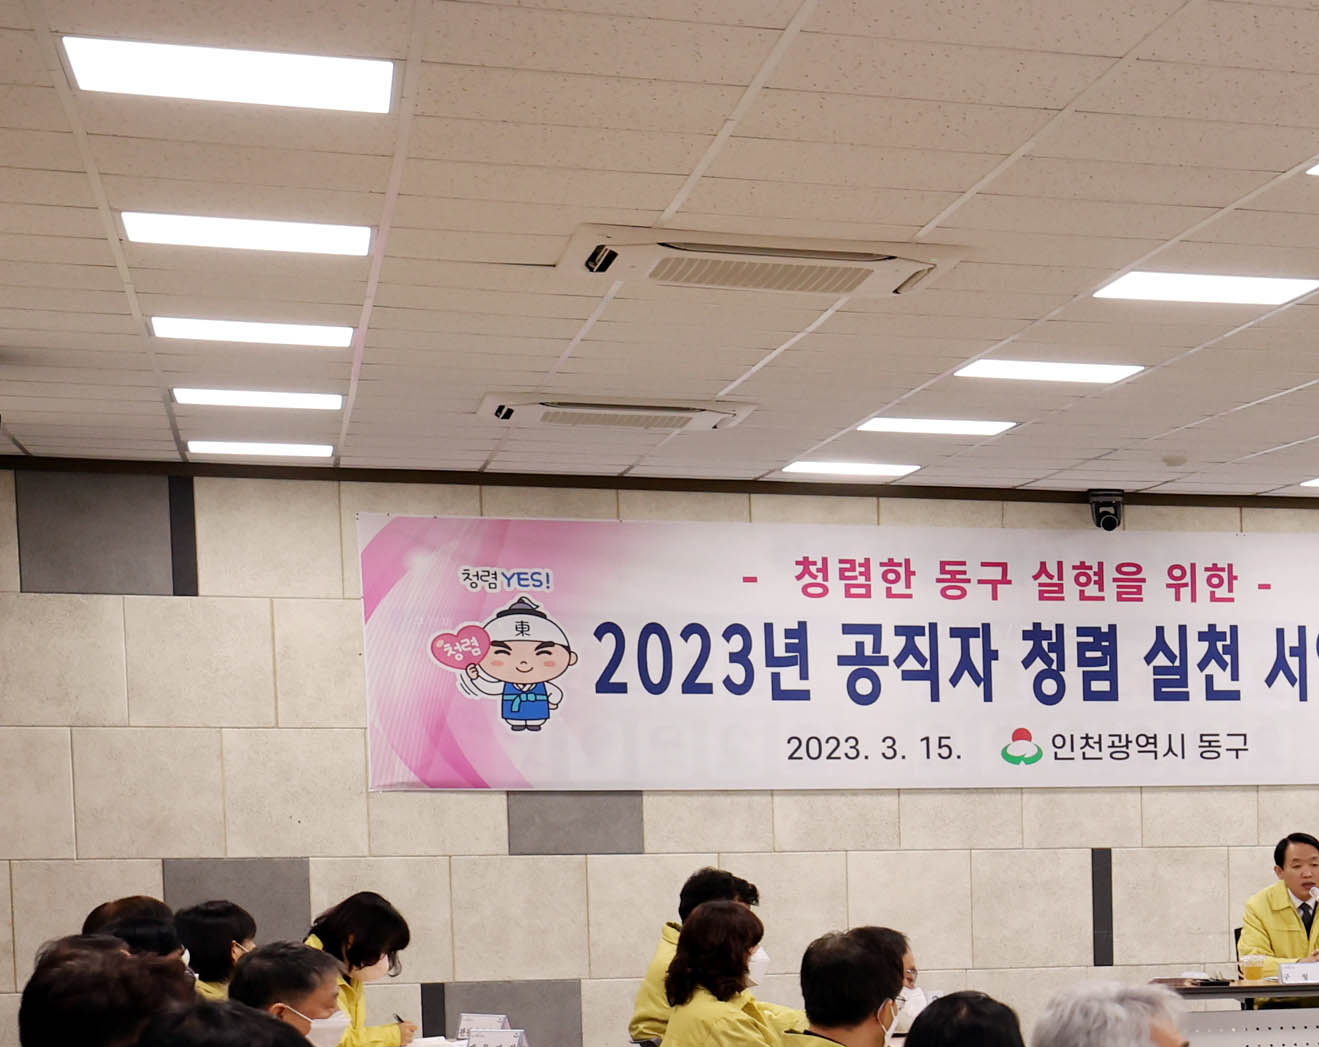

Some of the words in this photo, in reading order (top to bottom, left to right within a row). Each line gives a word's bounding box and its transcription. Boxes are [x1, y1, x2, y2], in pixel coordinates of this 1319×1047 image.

[461, 568, 498, 590] 청렴
[501, 571, 551, 590] YES!
[794, 556, 917, 599] 청렴한
[935, 560, 1013, 601] 동구
[1031, 560, 1147, 602] 실현을
[1165, 562, 1239, 603] 위한
[514, 620, 531, 637] 東
[443, 636, 481, 661] 청렴
[593, 621, 811, 702] 2023년
[836, 621, 1000, 707] 공직자
[1020, 621, 1119, 707] 청렴
[1143, 623, 1241, 702] 실천
[786, 735, 869, 761] 2023.
[881, 735, 906, 761] 3.
[919, 735, 962, 760] 15.
[1051, 732, 1186, 761] 인천광역시
[1197, 733, 1249, 761] 동구
